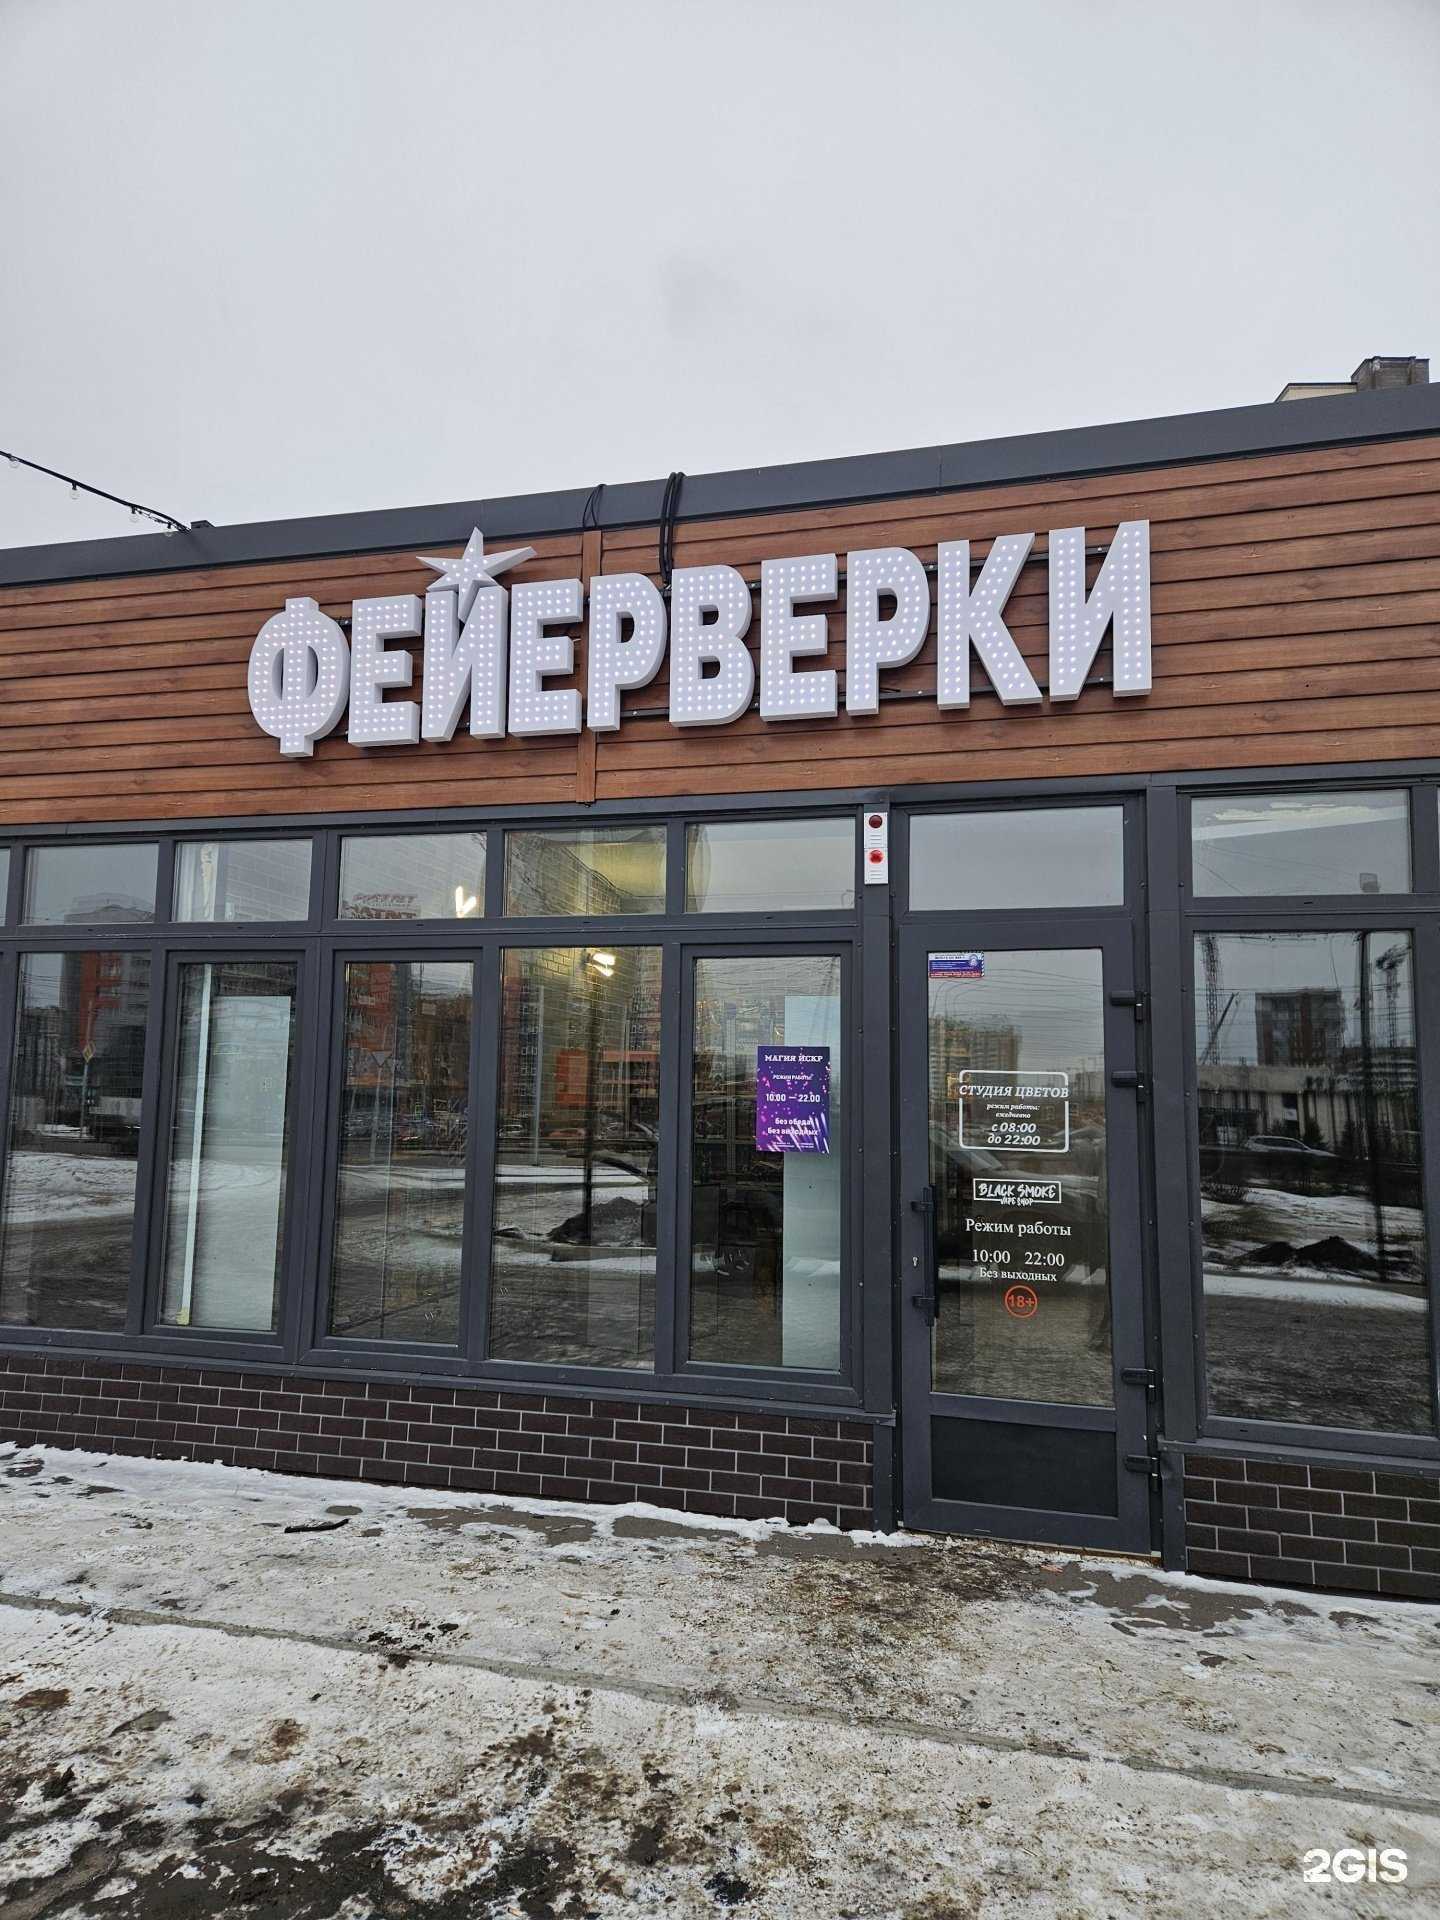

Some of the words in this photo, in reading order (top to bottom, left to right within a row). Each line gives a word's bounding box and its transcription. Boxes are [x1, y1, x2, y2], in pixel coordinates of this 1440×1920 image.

[247, 519, 1153, 758] ФЕЙЕРВЕРКИ
[764, 1054, 796, 1062] МАГИЯ
[798, 1055, 823, 1063] ИСКР
[959, 1085, 1012, 1098] СТУДИЯ
[1014, 1086, 1069, 1099] ЦВЕТОВ
[1000, 1122, 1037, 1133] 08:00
[987, 1134, 1002, 1144] до
[1003, 1135, 1041, 1146] 22:00
[978, 1183, 1016, 1198] BLACK
[1017, 1184, 1057, 1199] SMOKE
[1000, 1197, 1016, 1206] VAPE
[1017, 1197, 1034, 1207] SHOP
[965, 1218, 1014, 1234] Режим
[1017, 1221, 1072, 1238] работы
[972, 1249, 1011, 1264] 10:00
[1024, 1251, 1065, 1267] 22:00
[980, 1267, 998, 1279] Без
[1001, 1271, 1057, 1282] выходных
[1008, 1295, 1035, 1308] 18+
